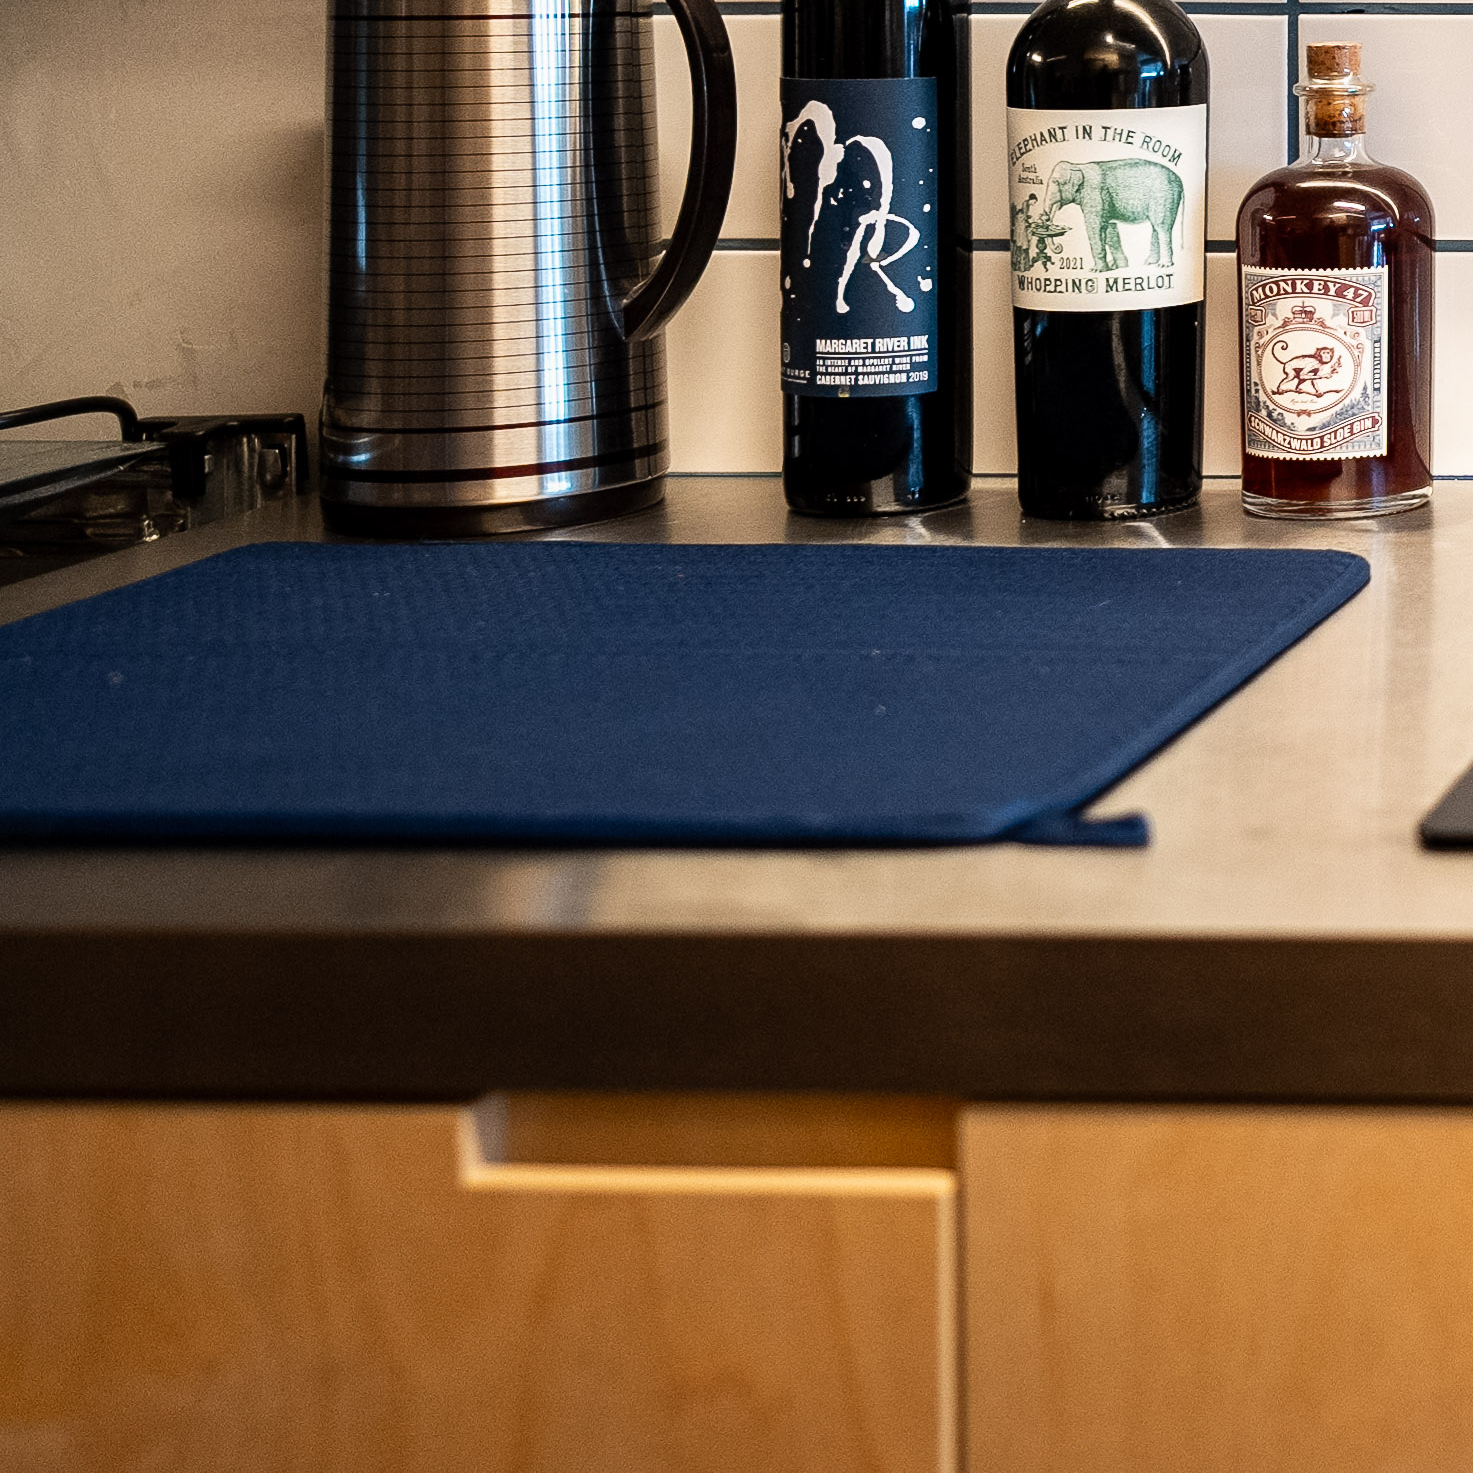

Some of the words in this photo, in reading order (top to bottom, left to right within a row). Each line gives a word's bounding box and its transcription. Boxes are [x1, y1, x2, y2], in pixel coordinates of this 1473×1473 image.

[1010, 125, 1067, 167] ELEPHANT
[1075, 125, 1093, 140] IN
[1100, 126, 1136, 144] THE
[1140, 132, 1183, 167] ROOM
[1059, 257, 1084, 270] 2021
[1017, 274, 1098, 294] WHOPPING
[1105, 274, 1174, 293] MERLOT
[1251, 279, 1341, 303] MONKEY
[1342, 287, 1370, 302] 47
[816, 338, 874, 353] MARGARET
[875, 337, 908, 352] RIVER
[909, 335, 929, 348] INK
[816, 375, 856, 385] CABERNET
[858, 373, 907, 385] SAUVIGNON
[908, 371, 929, 382] 2019
[1250, 416, 1321, 451] SCHWARZWALD
[1323, 428, 1351, 447] SLOE
